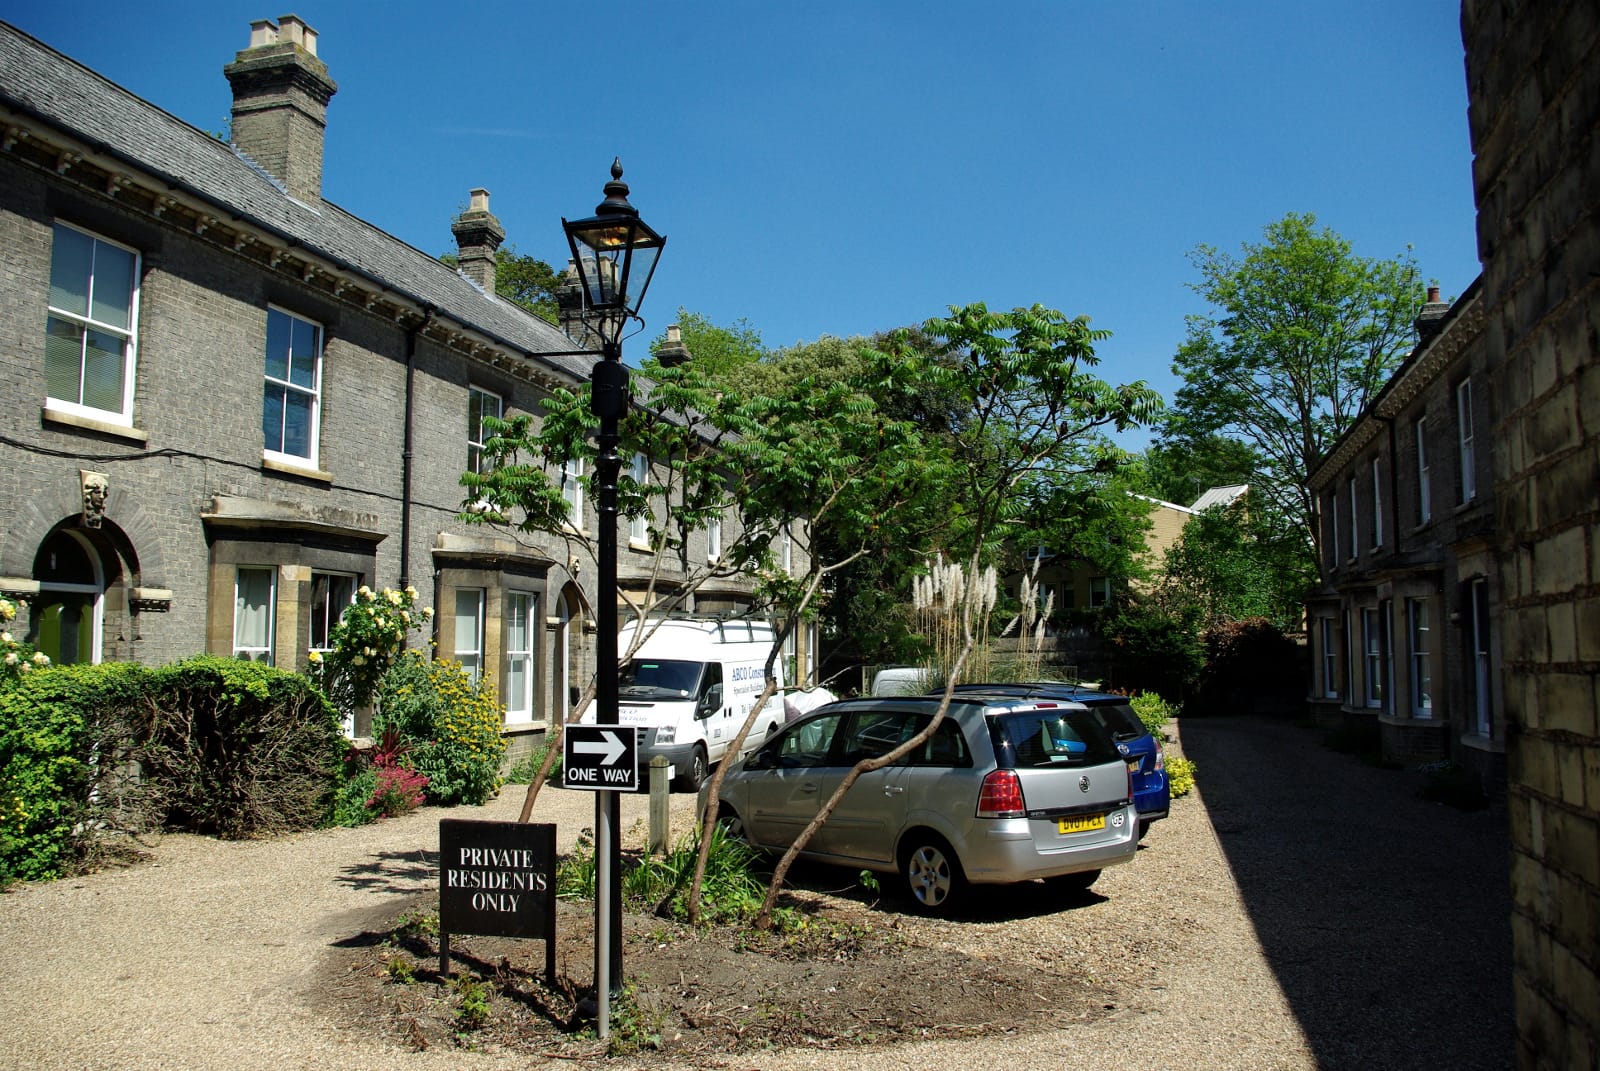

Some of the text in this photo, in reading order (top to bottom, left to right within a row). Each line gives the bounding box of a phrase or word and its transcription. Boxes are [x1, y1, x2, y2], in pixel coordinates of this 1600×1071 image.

[732, 667, 747, 681] ABCO
[568, 767, 631, 783] ONE WAY
[460, 847, 533, 868] PRIVATE
[447, 869, 547, 891] RESIDENTS
[472, 892, 520, 913] ONLY
